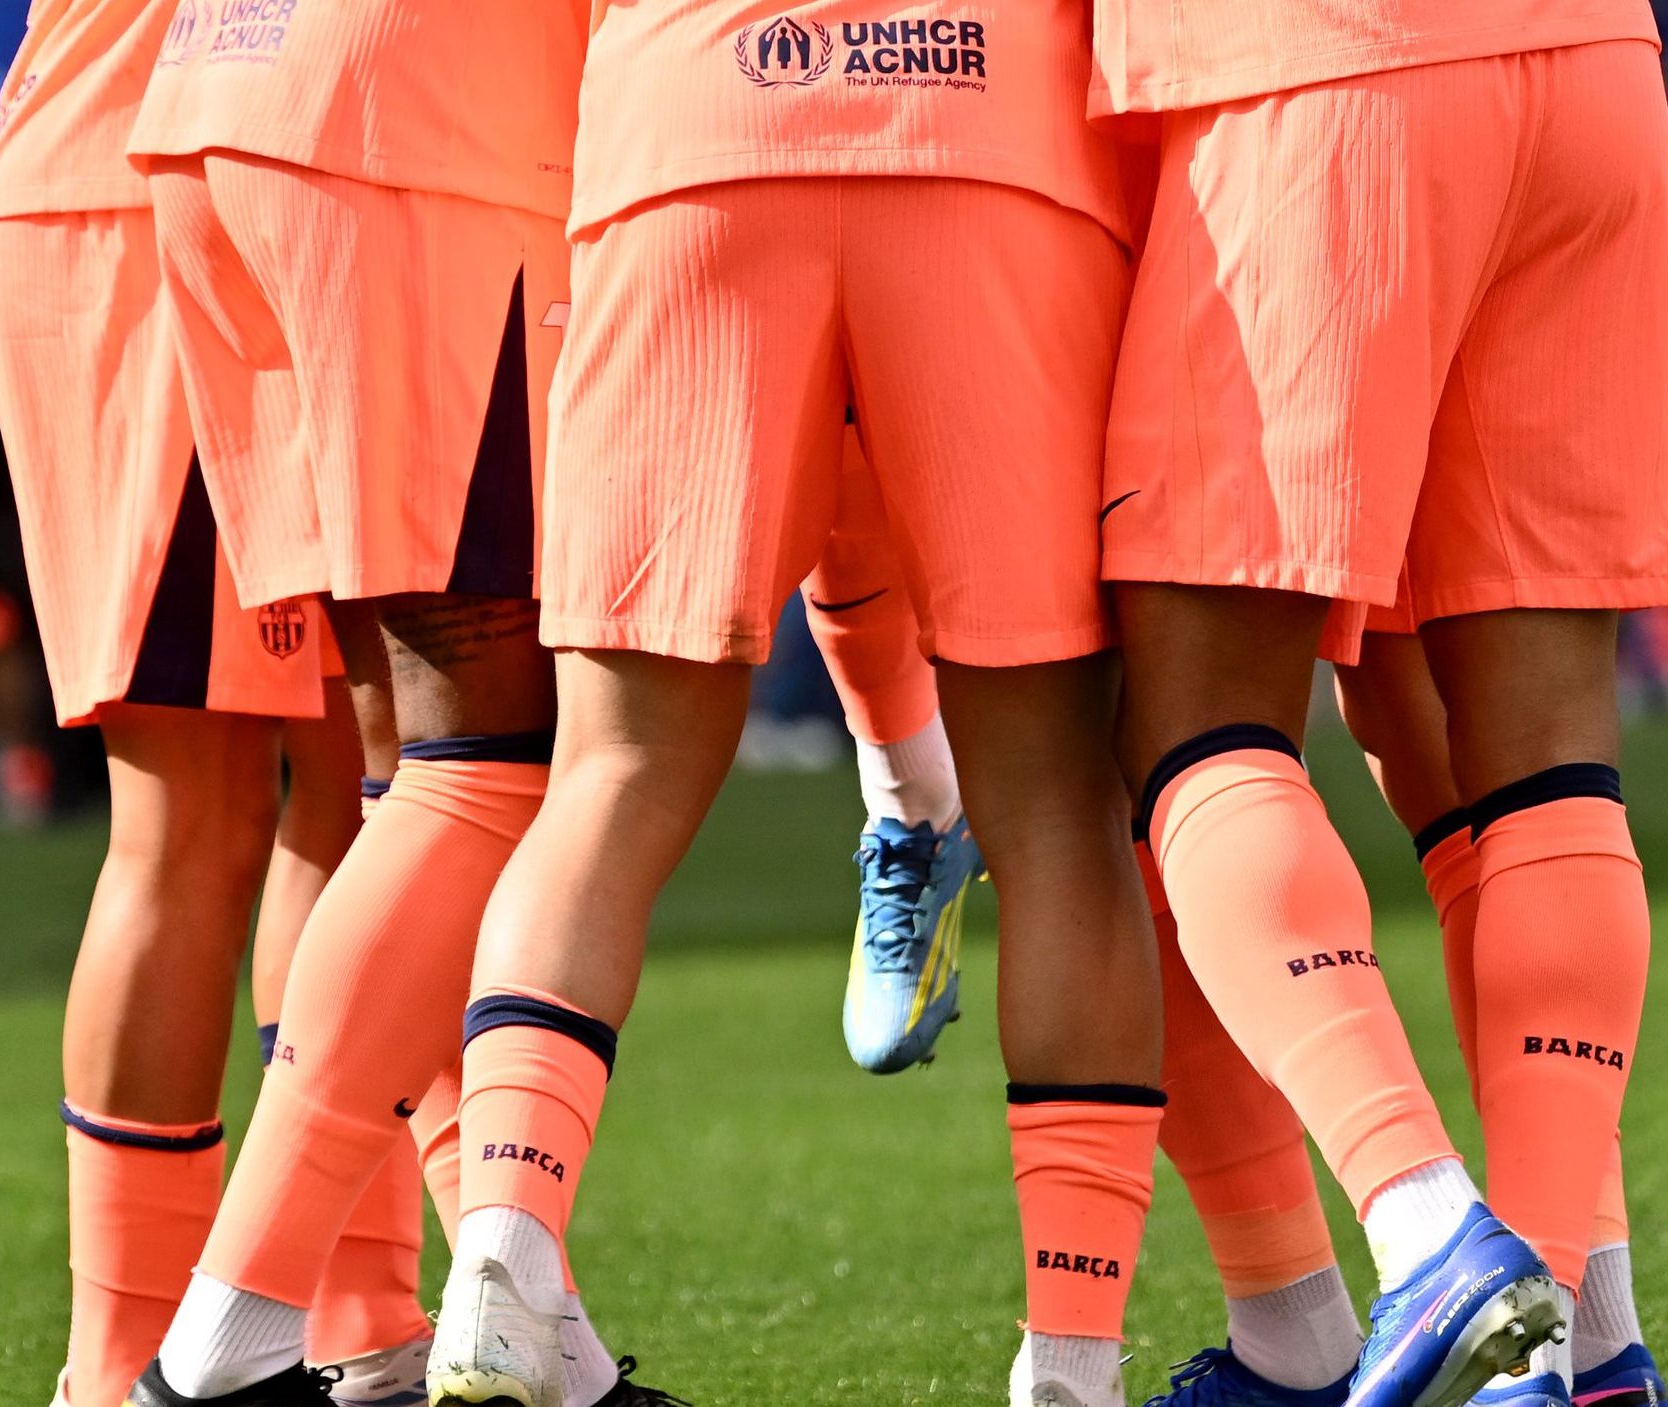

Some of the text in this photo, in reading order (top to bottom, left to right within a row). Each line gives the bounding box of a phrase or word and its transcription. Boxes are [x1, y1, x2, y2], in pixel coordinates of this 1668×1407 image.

[208, 24, 285, 54] ACNUR
[842, 19, 985, 48] UNHCR
[843, 47, 986, 78] ACNUR
[845, 77, 986, 93] The UN Refugee Agency
[1287, 950, 1380, 977] BARÇA
[1523, 1036, 1623, 1071] BARÇA
[482, 1143, 565, 1183] BARÇA
[1036, 1250, 1119, 1279] BARÇA
[1466, 1265, 1505, 1296] ZOOM
